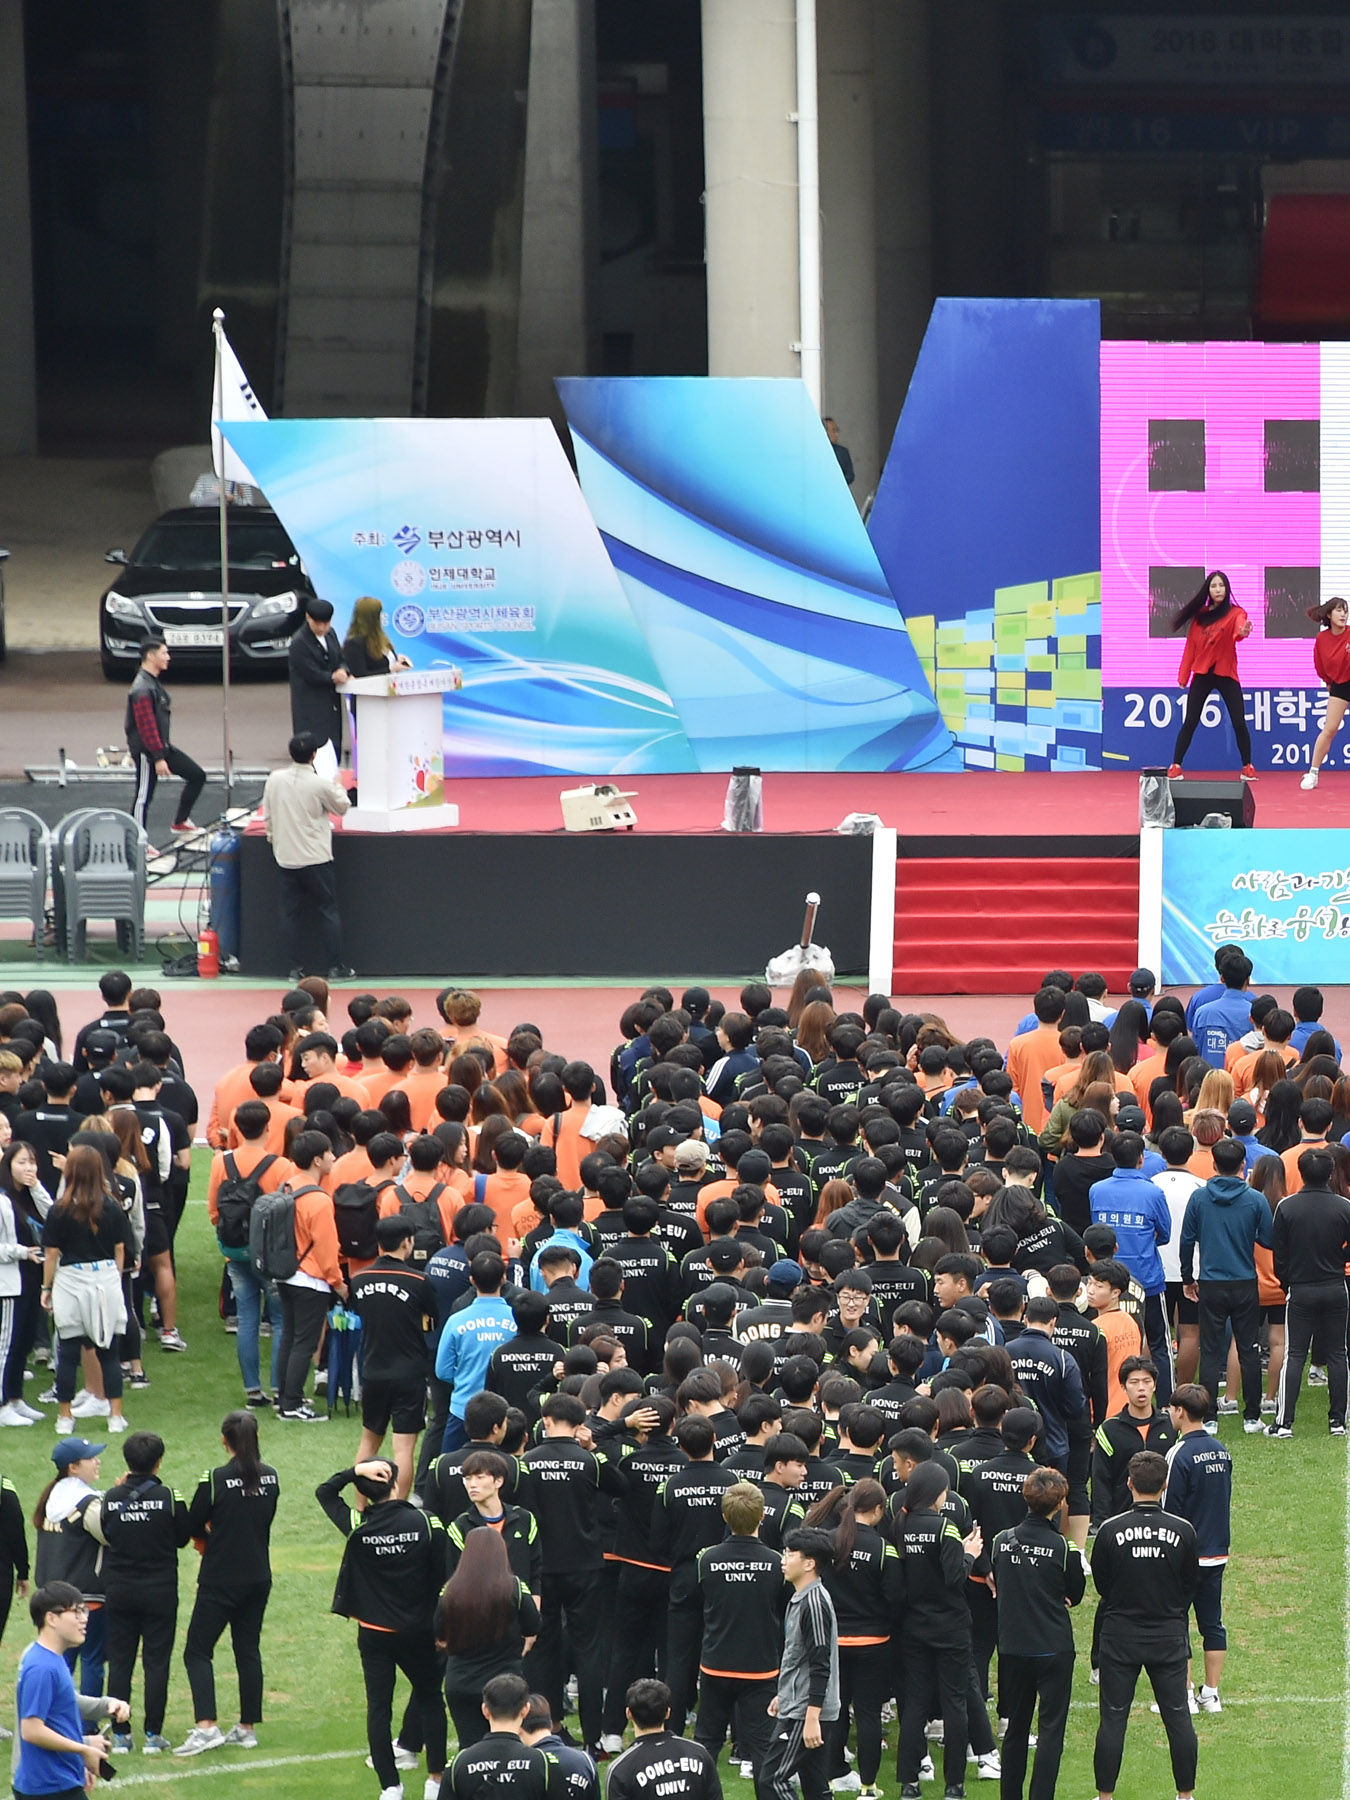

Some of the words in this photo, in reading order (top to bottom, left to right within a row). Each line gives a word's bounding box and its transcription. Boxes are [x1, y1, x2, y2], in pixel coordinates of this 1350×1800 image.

[1153, 30, 1217, 53] 2016
[1238, 119, 1301, 145] VIP
[428, 530, 521, 549] 부산광역시
[429, 568, 496, 581] 인제대학교
[428, 606, 536, 621] 부산광역시체육회
[1098, 1212, 1145, 1226] 대의원회
[1027, 1240, 1052, 1253] UNIV.
[455, 1315, 519, 1338] DONG-EU
[476, 1331, 506, 1343] UNIV.
[1051, 1337, 1078, 1347] UNIV.
[501, 1352, 555, 1365] DONG-EUI
[512, 1362, 542, 1374] UNIV.
[1017, 1371, 1040, 1381] UNIV.
[528, 1460, 585, 1473] DONG-EUI
[540, 1470, 571, 1483] UNIV.
[992, 1481, 1021, 1494] UNIV.
[686, 1497, 717, 1508] UNIV.
[120, 1511, 151, 1522] UNIV.
[362, 1532, 420, 1547] DONG-EUI
[1115, 1525, 1181, 1548] DONG-EUI
[375, 1544, 407, 1557] UNIV.
[1131, 1546, 1166, 1559] UNIV.
[709, 1561, 773, 1574] DONG-EUI
[723, 1572, 757, 1584] UNIV.
[635, 1756, 704, 1788] DONG-EUI
[655, 1778, 691, 1797] UNIV.
